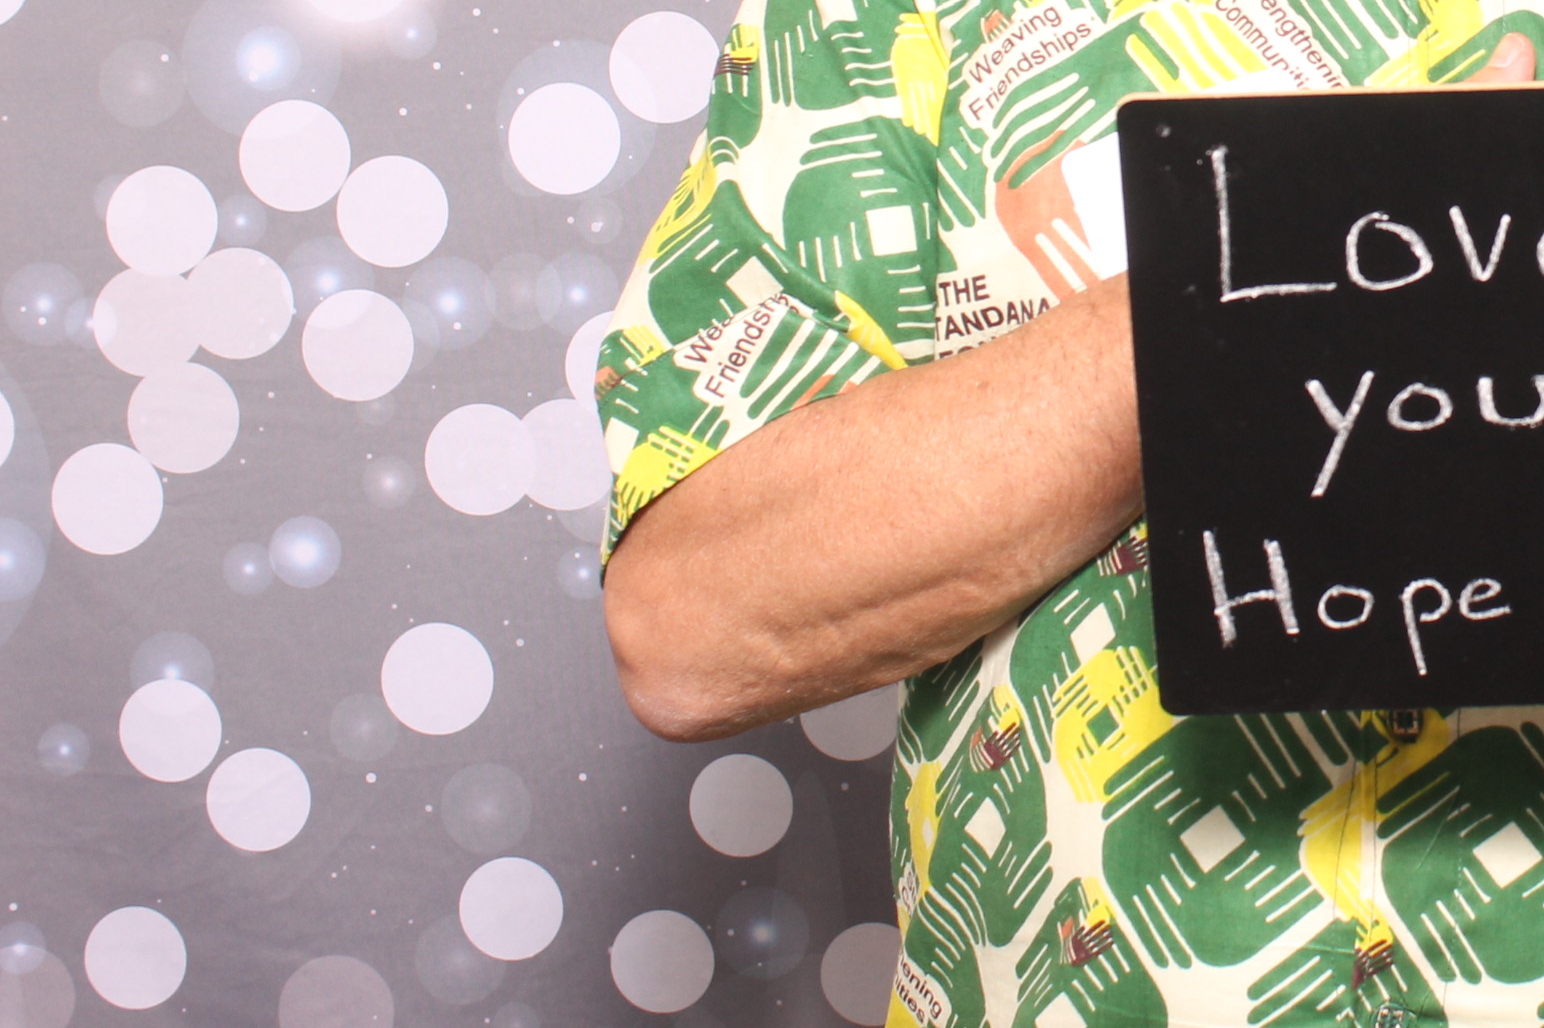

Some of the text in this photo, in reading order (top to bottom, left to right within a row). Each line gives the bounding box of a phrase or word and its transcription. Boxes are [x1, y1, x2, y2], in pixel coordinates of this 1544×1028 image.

[968, 23, 1091, 121] Friendships
[969, 6, 1062, 83] Weaving
[938, 274, 991, 307] THE
